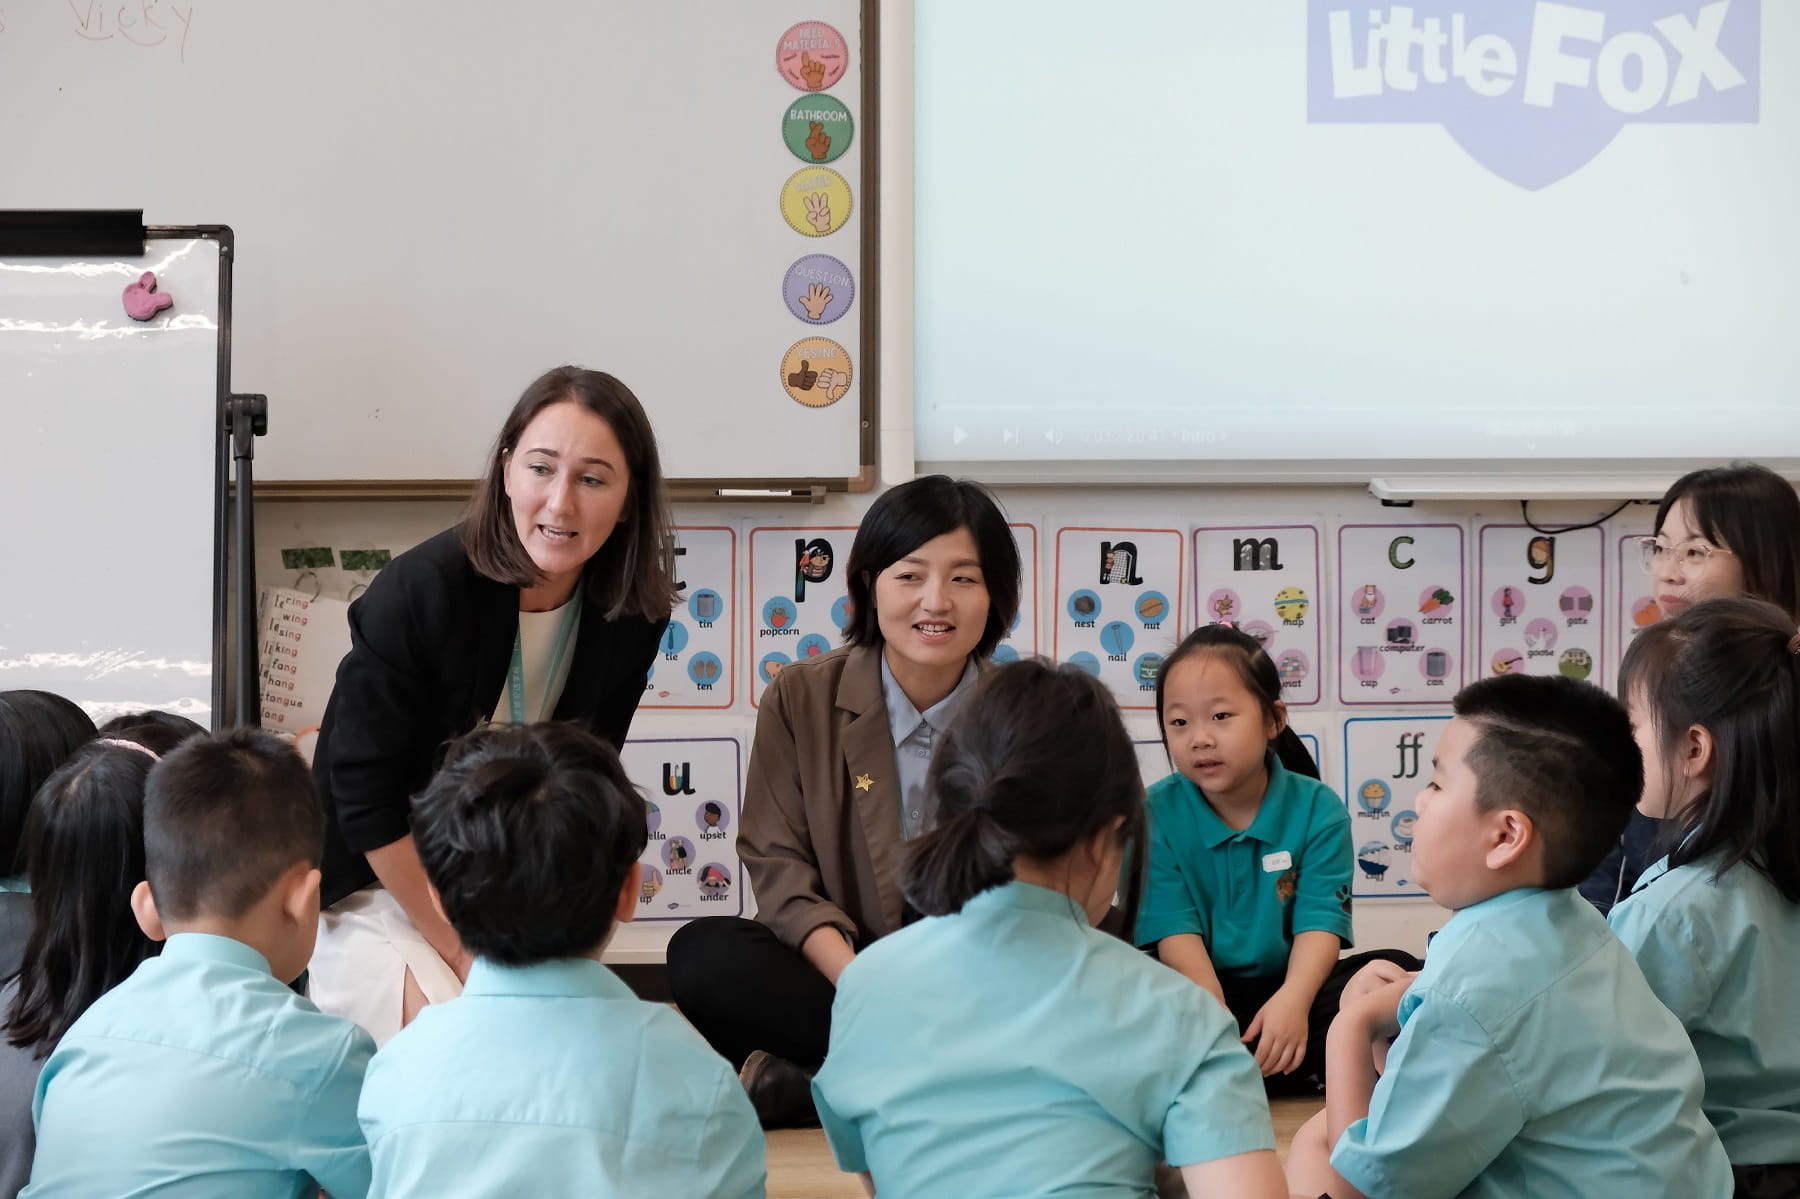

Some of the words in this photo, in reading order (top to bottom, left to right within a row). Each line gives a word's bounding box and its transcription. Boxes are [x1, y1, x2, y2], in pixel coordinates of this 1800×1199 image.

[68, 0, 193, 63] Vicky
[783, 38, 841, 50] MATERIALS
[790, 109, 848, 122] BATHROOM
[794, 264, 849, 288] QUESTION
[1233, 537, 1283, 571] m
[1100, 541, 1143, 586] n
[1527, 536, 1556, 585] g
[795, 538, 833, 603] p
[285, 595, 309, 610] ring
[282, 613, 308, 626] wing
[698, 620, 713, 628] tin
[1074, 620, 1095, 628] nest
[1283, 619, 1304, 628] map
[1360, 617, 1376, 625] cat
[1422, 617, 1453, 625] carrot
[1143, 622, 1160, 630] nut
[278, 628, 302, 641] sing
[760, 628, 800, 638] popcorn
[275, 642, 298, 657] king
[1379, 642, 1425, 653] computer
[665, 653, 678, 661] tie
[1108, 653, 1127, 662] nail
[272, 658, 297, 674] fang
[267, 674, 295, 691] hang
[696, 683, 713, 691] ten
[1360, 680, 1378, 688] cup
[264, 692, 303, 708] tongue
[1392, 732, 1425, 779] ff
[662, 762, 696, 796] u
[1357, 807, 1390, 819] muffin
[700, 831, 727, 842] upset
[1393, 841, 1412, 853] coff
[665, 867, 692, 875] uncle
[640, 896, 653, 905] up
[699, 893, 729, 901] under
